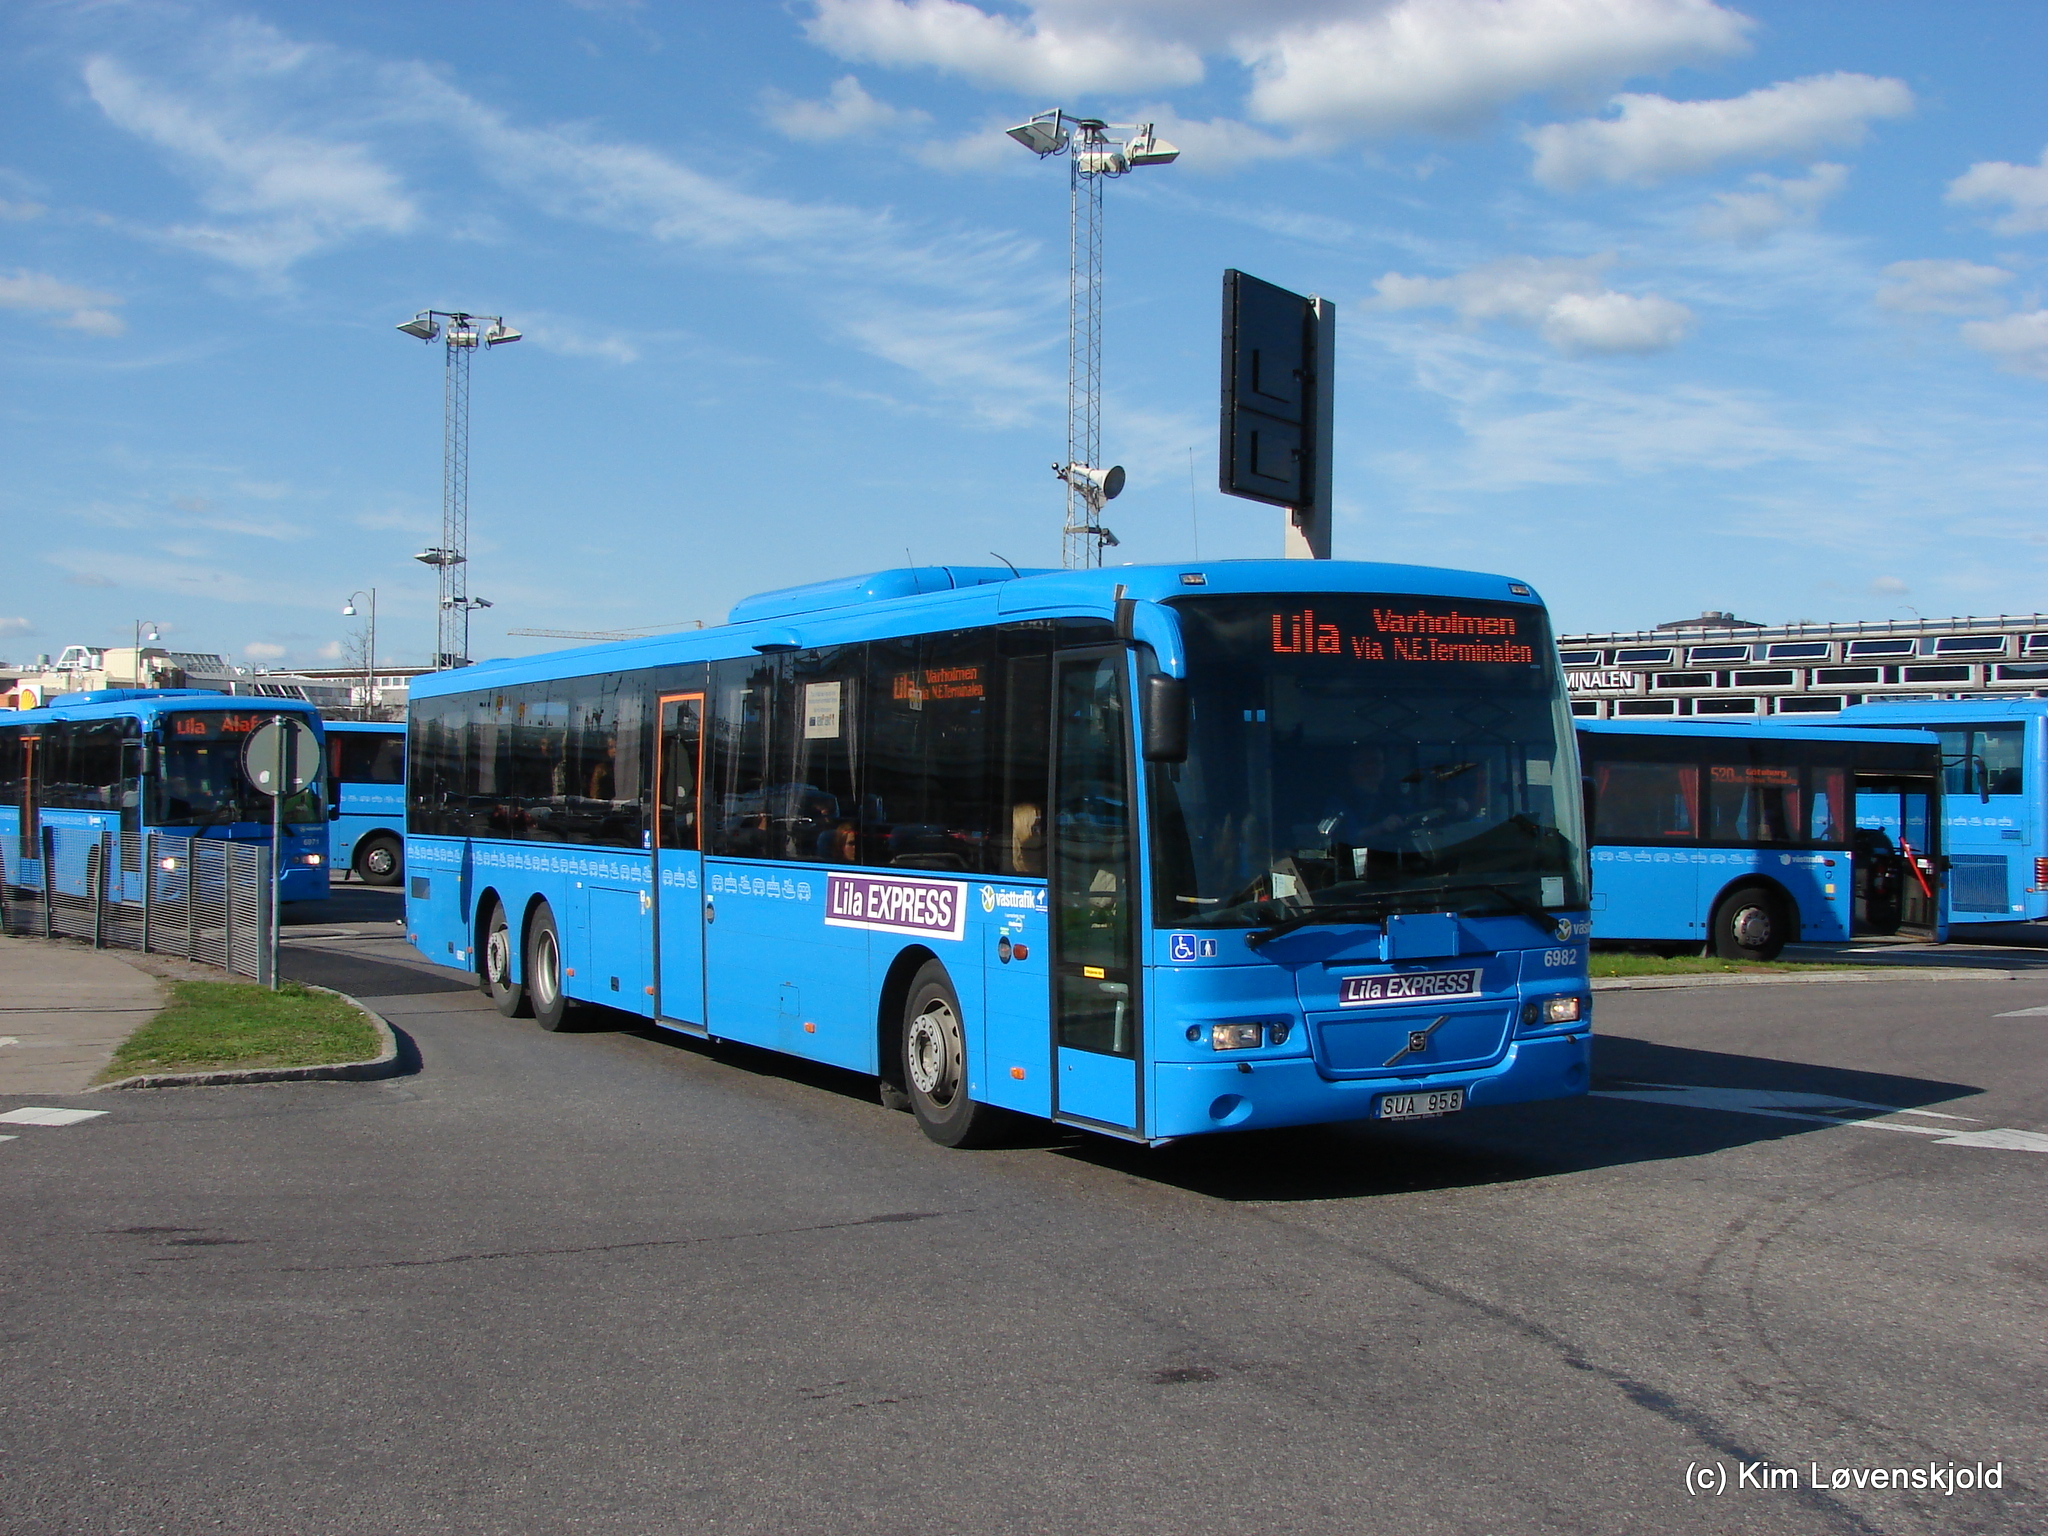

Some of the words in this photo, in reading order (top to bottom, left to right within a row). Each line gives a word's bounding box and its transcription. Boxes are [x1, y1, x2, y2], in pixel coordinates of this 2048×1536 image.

[1272, 609, 1342, 653] Lila
[1373, 609, 1516, 635] Varholmen
[1351, 636, 1385, 660] Via
[926, 667, 978, 684] Varholmen
[176, 717, 206, 735] Lila
[1710, 767, 1735, 782] 520
[833, 880, 863, 916] Lila
[867, 884, 952, 927] EXPRESS
[995, 888, 1035, 909] västtrafik
[1544, 949, 1577, 967] 6982
[1348, 978, 1381, 1000] Lila
[1387, 973, 1470, 997] EXPRESS
[1383, 1096, 1415, 1115] SUA
[1428, 1092, 1460, 1111] 958
